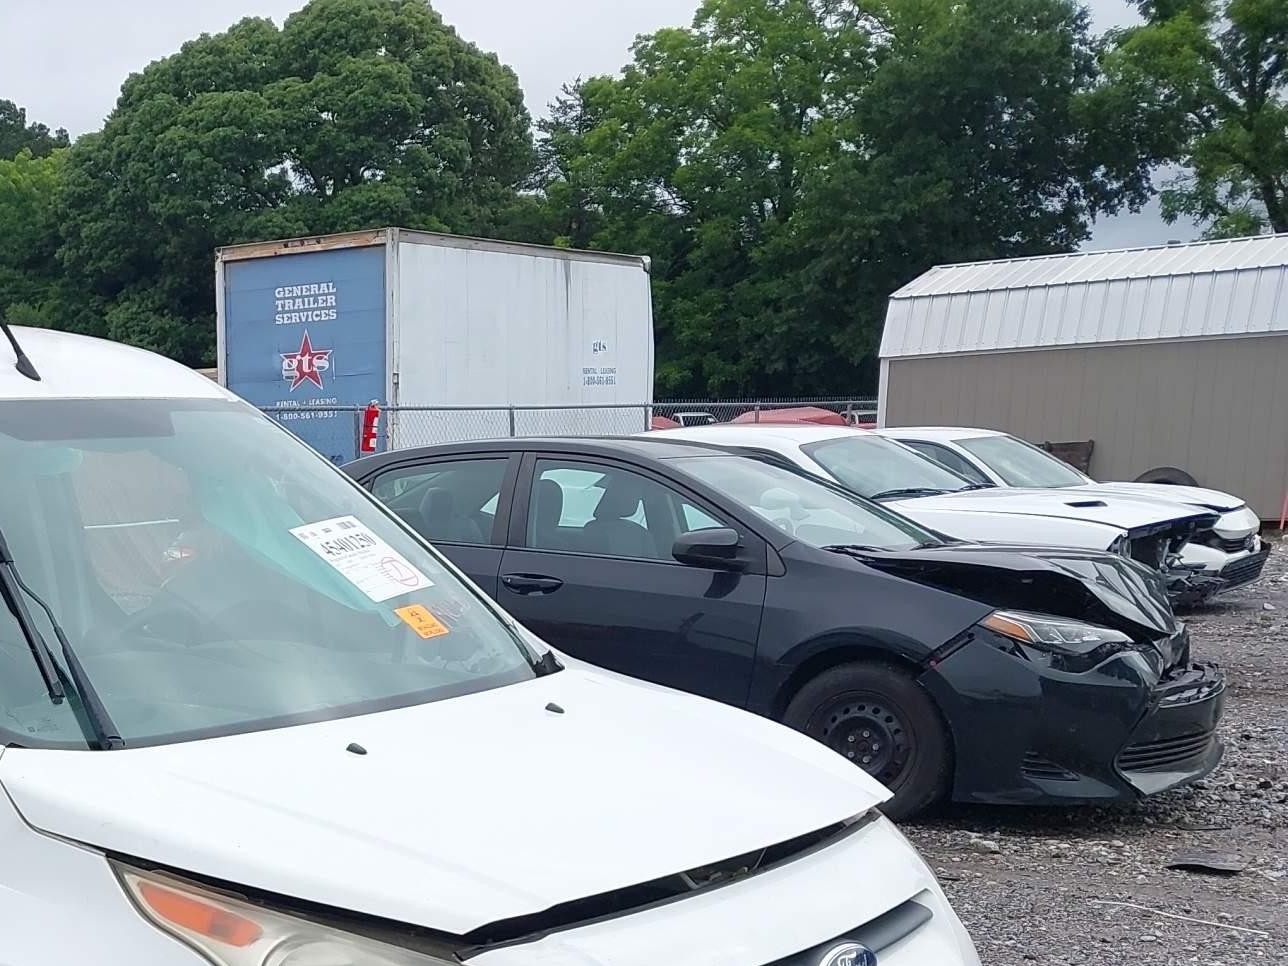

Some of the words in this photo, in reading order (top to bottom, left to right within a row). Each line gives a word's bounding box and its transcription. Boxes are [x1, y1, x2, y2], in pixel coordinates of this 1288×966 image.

[275, 282, 337, 298] GENERAL
[275, 295, 337, 311] TRAILER
[275, 309, 337, 325] SERVICES
[593, 340, 607, 354] gts
[282, 352, 330, 382] gts
[320, 533, 377, 557] 45401250
